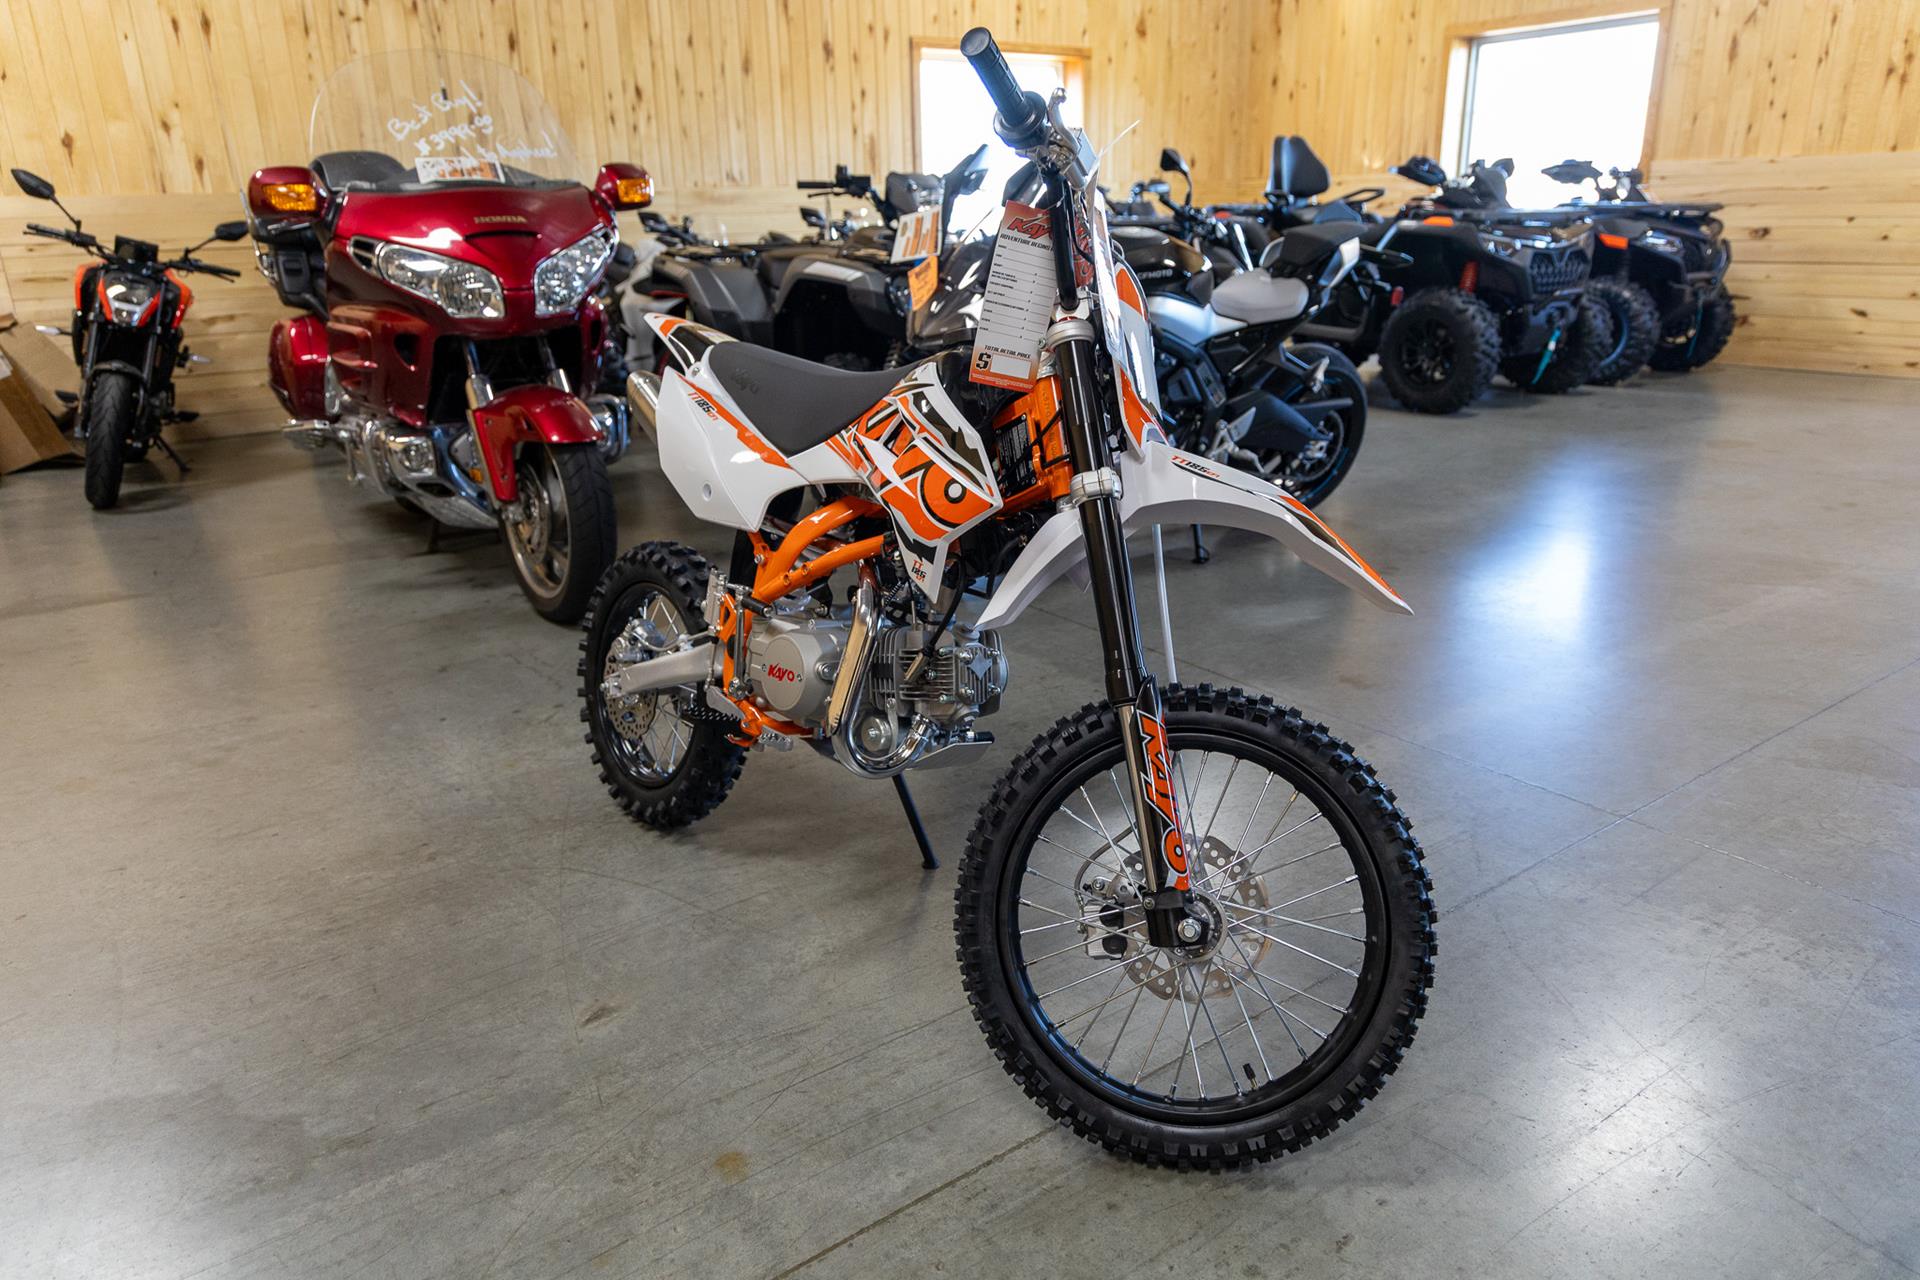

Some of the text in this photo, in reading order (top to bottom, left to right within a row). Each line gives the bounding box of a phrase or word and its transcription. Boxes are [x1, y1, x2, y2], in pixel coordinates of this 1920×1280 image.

[474, 215, 527, 224] HONDA
[1007, 216, 1055, 240] KAY
[976, 352, 991, 370] $
[768, 663, 795, 682] KAYO
